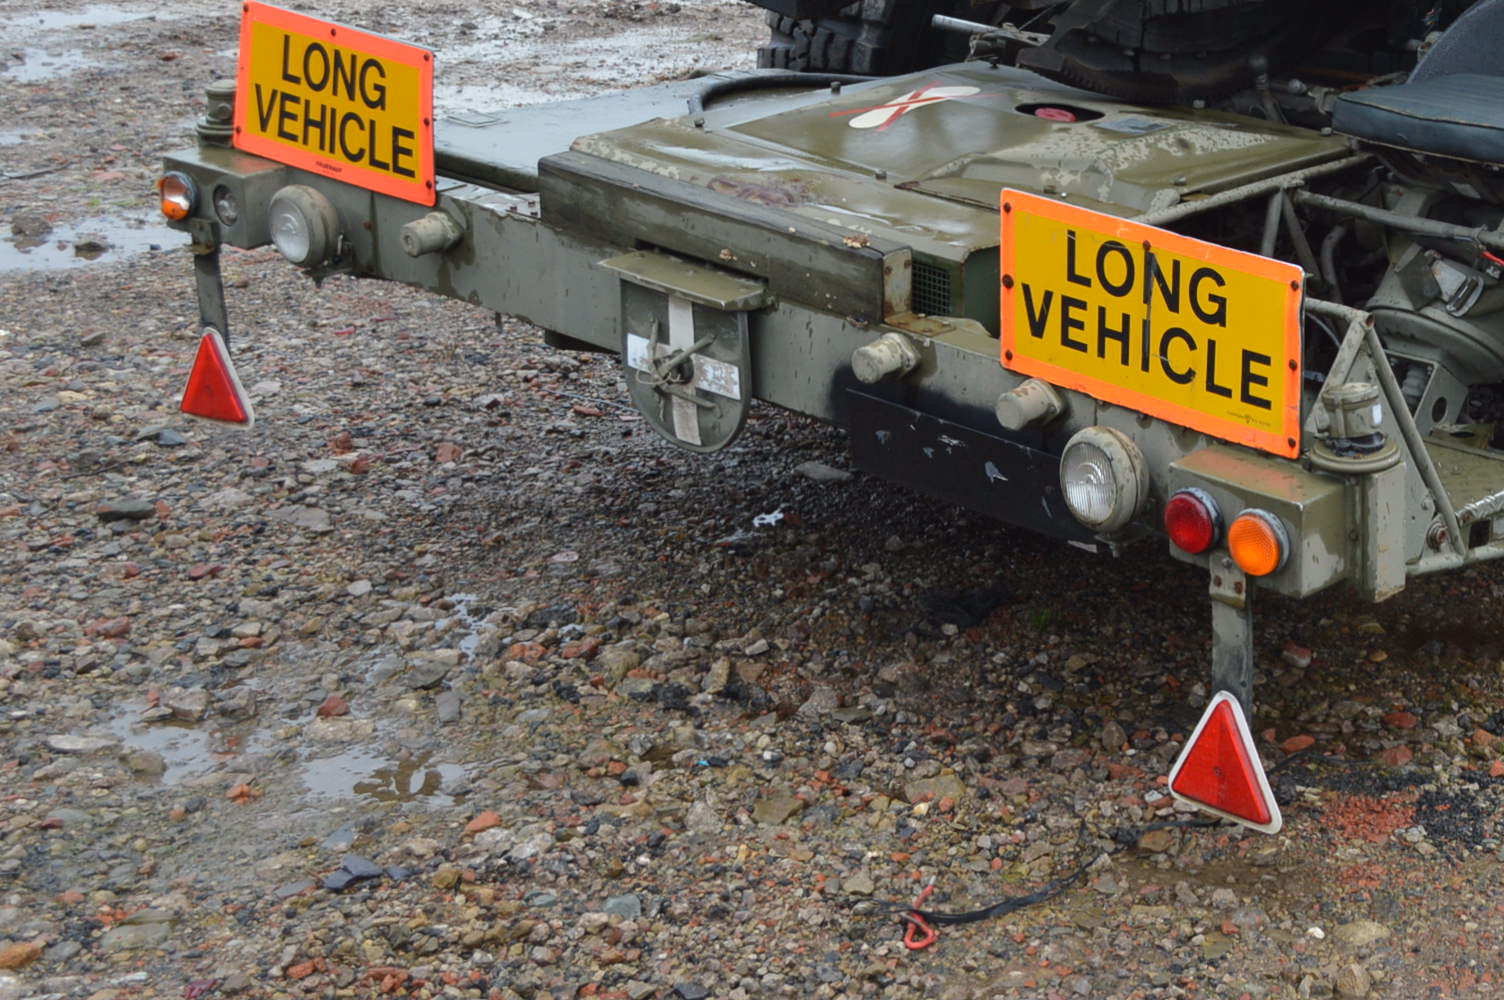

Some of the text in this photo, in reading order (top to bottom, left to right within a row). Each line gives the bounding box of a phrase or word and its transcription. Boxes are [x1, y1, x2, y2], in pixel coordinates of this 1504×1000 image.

[282, 34, 387, 111] LONG
[255, 83, 416, 178] VEHICLE
[1066, 229, 1227, 328] LONG
[1021, 282, 1272, 410] VEHICLE
